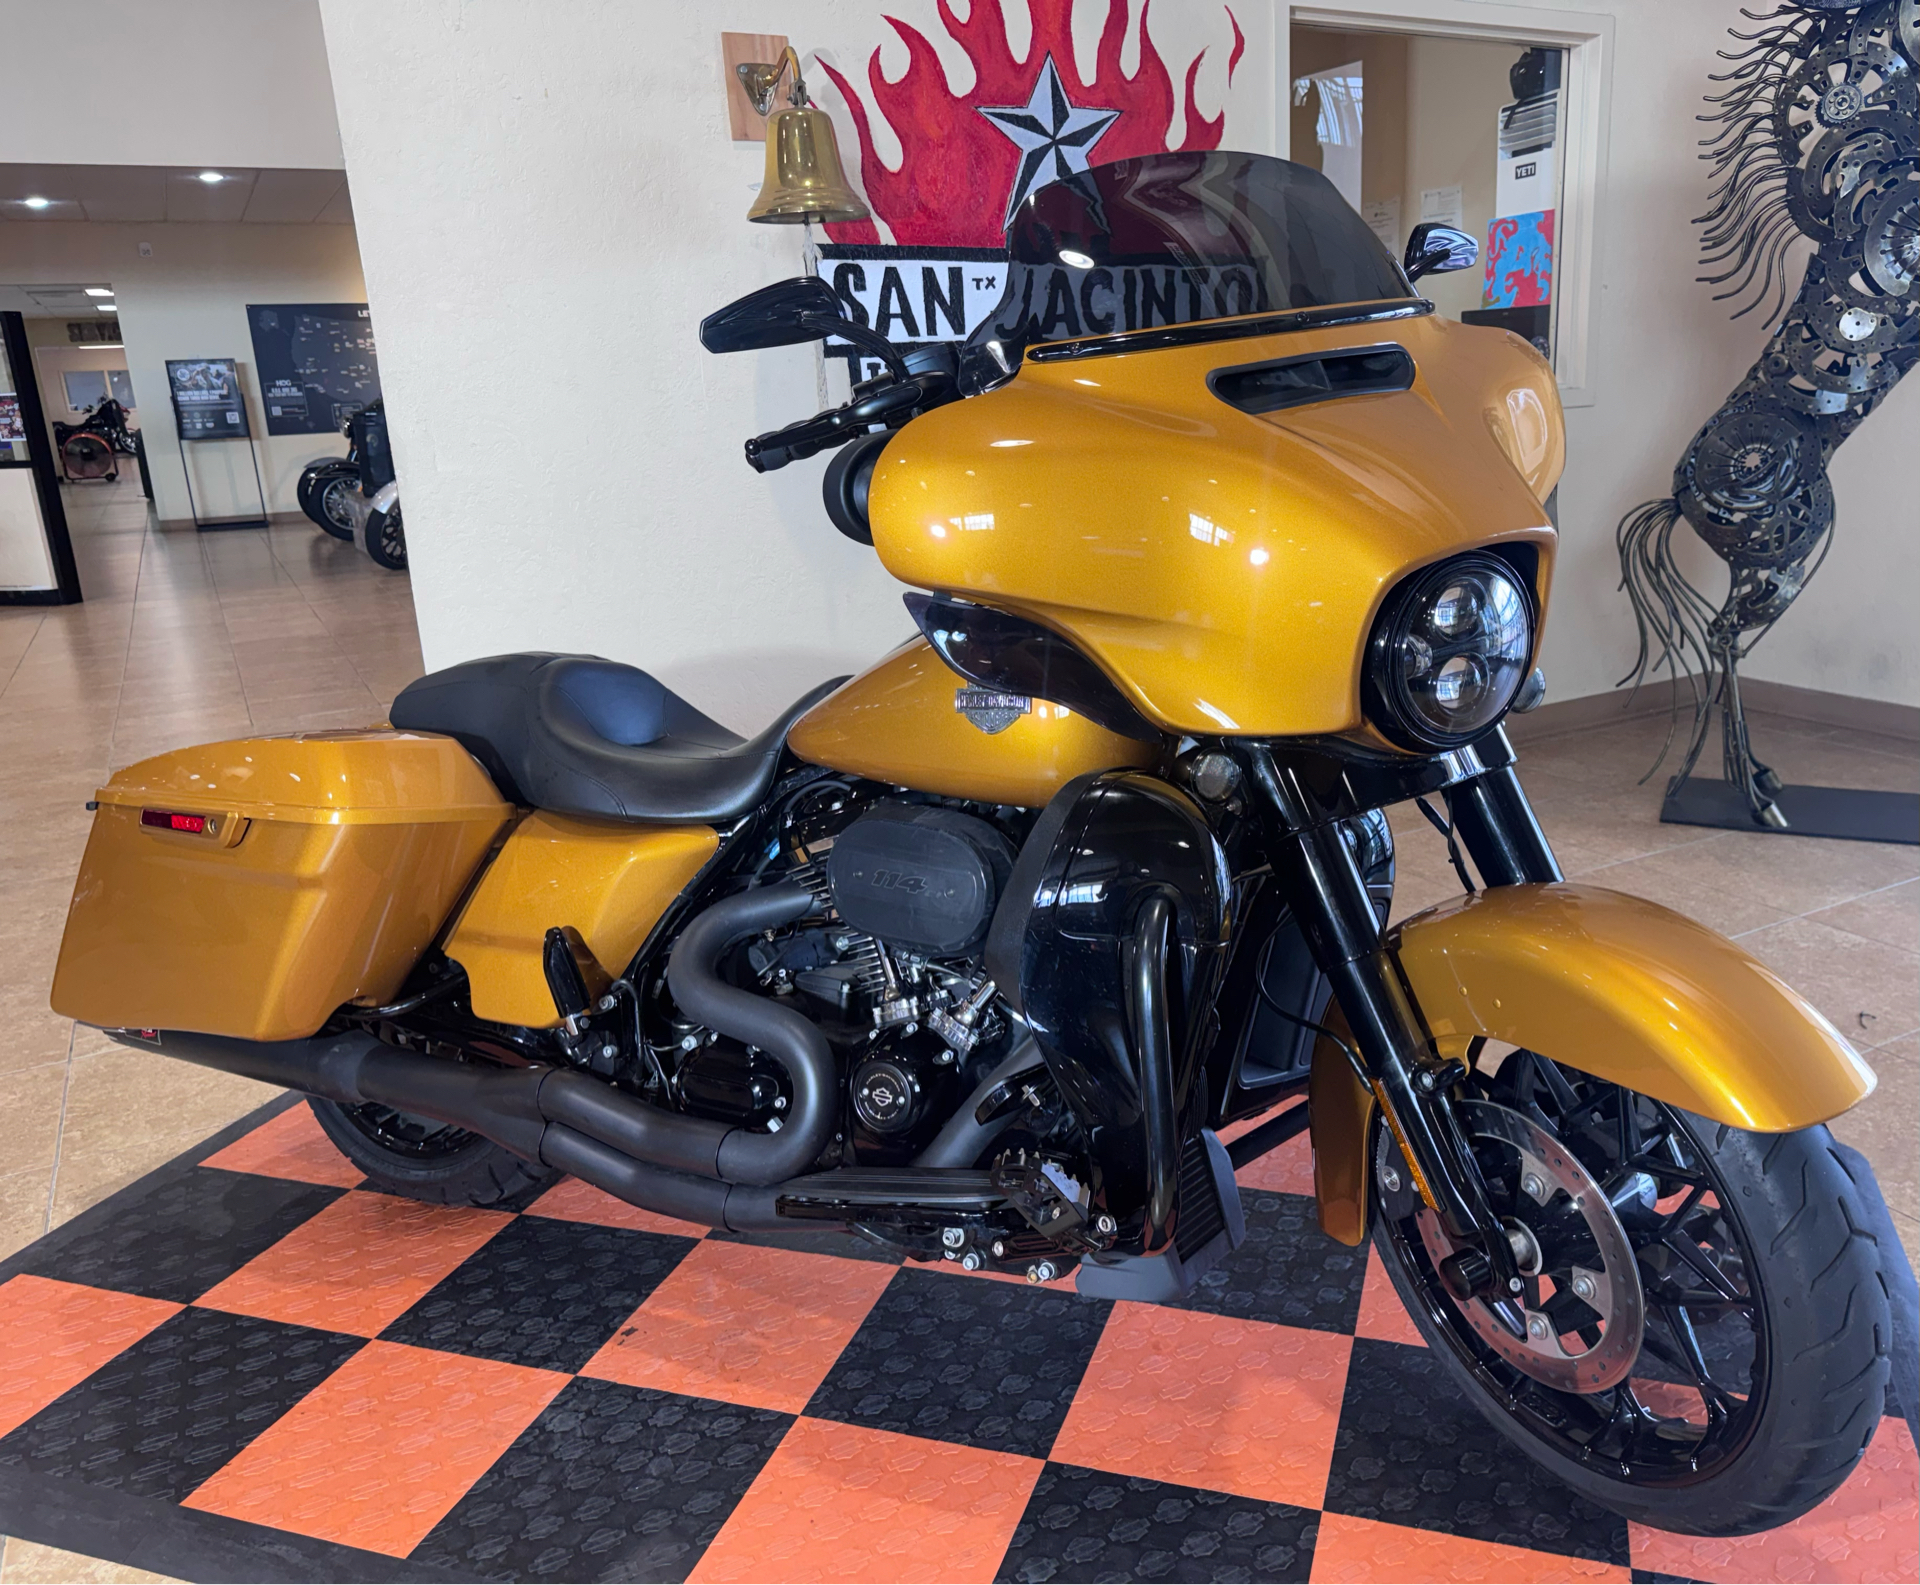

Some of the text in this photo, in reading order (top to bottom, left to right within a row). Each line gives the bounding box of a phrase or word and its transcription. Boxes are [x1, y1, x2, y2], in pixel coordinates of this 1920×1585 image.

[1516, 164, 1535, 178] YETI
[972, 276, 996, 291] TX
[833, 262, 1253, 338] SAN JACINTO
[871, 868, 928, 895] 114
